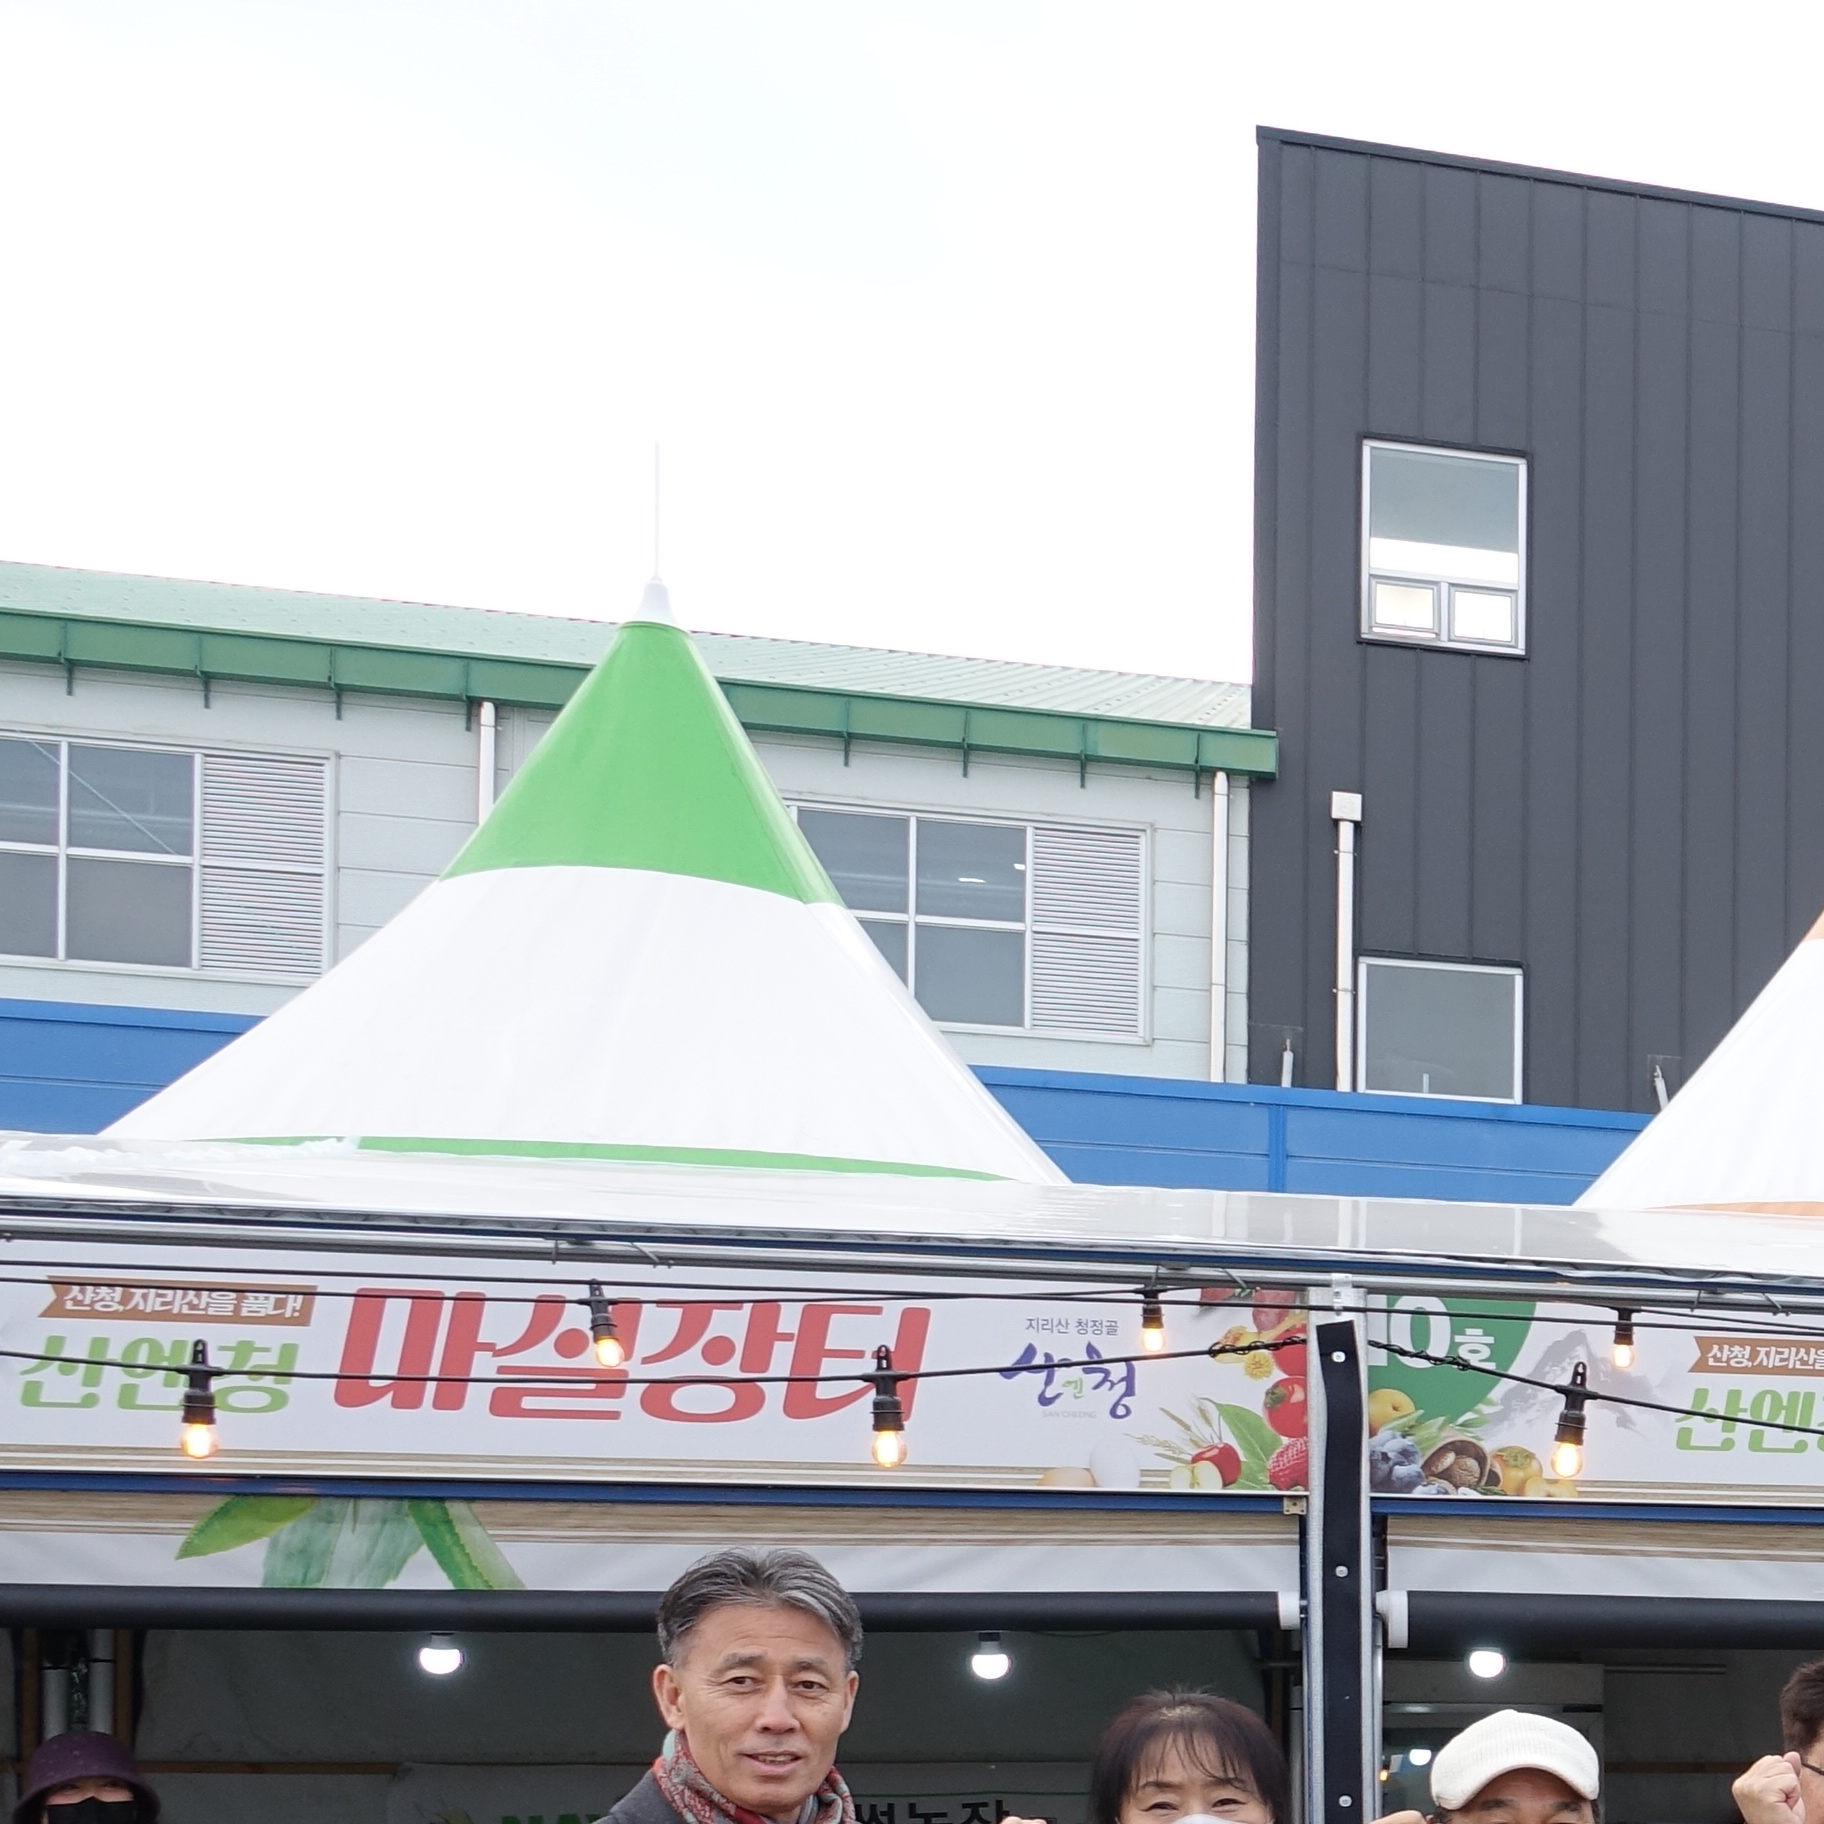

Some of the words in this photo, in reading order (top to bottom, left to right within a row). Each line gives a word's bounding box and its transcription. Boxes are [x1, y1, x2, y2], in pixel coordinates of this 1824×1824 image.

[241, 1292, 300, 1318] 품다!
[1025, 1318, 1070, 1334] 지리산
[1075, 1318, 1119, 1336] 청정골
[20, 1335, 299, 1413] 산엔청
[334, 1286, 932, 1424] 마실장터
